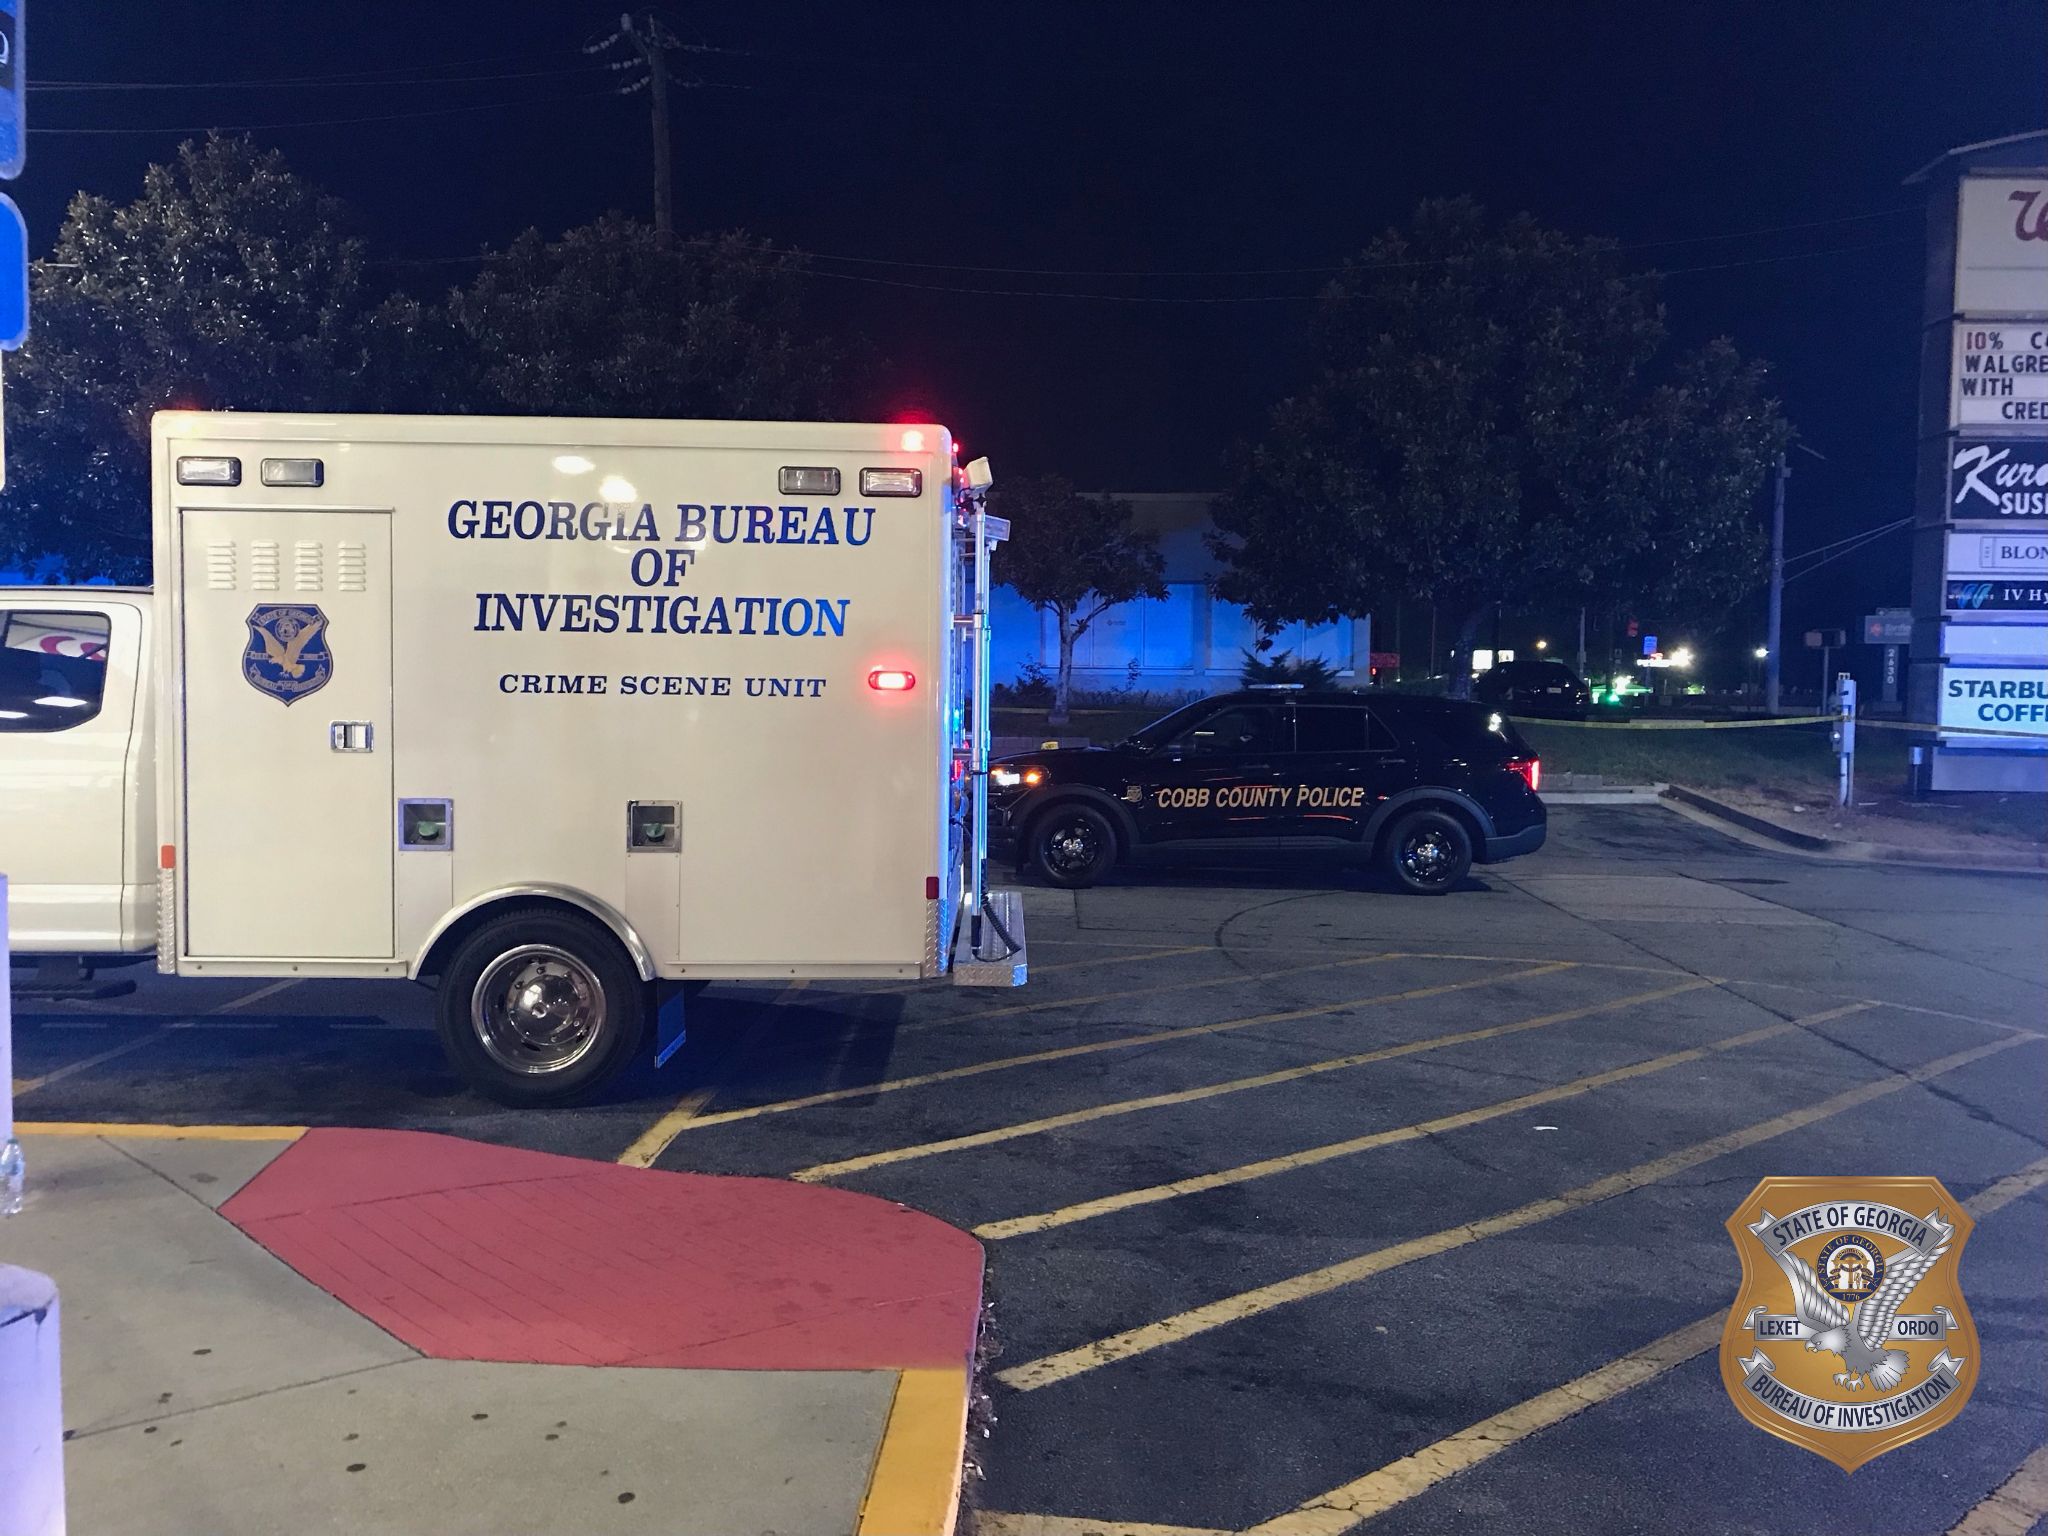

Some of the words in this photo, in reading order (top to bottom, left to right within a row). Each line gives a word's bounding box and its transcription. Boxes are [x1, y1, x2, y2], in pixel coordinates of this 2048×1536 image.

[1967, 332, 2003, 350] 10%
[1961, 378, 2013, 396] WITH
[2001, 492, 2048, 514] SUS
[448, 500, 660, 542] GEORGIA
[675, 504, 875, 546] BUREAU
[630, 548, 695, 587] OF
[2004, 589, 2024, 601] IV
[474, 593, 850, 637] INVESTIGATION
[500, 674, 608, 695] CRIME
[620, 675, 732, 696] SCENE
[744, 677, 827, 698] UNIT
[1978, 703, 2048, 722] COFF
[1158, 788, 1210, 808] COBB
[1215, 787, 1293, 808] COUNTY
[1297, 787, 1365, 808] POLICE
